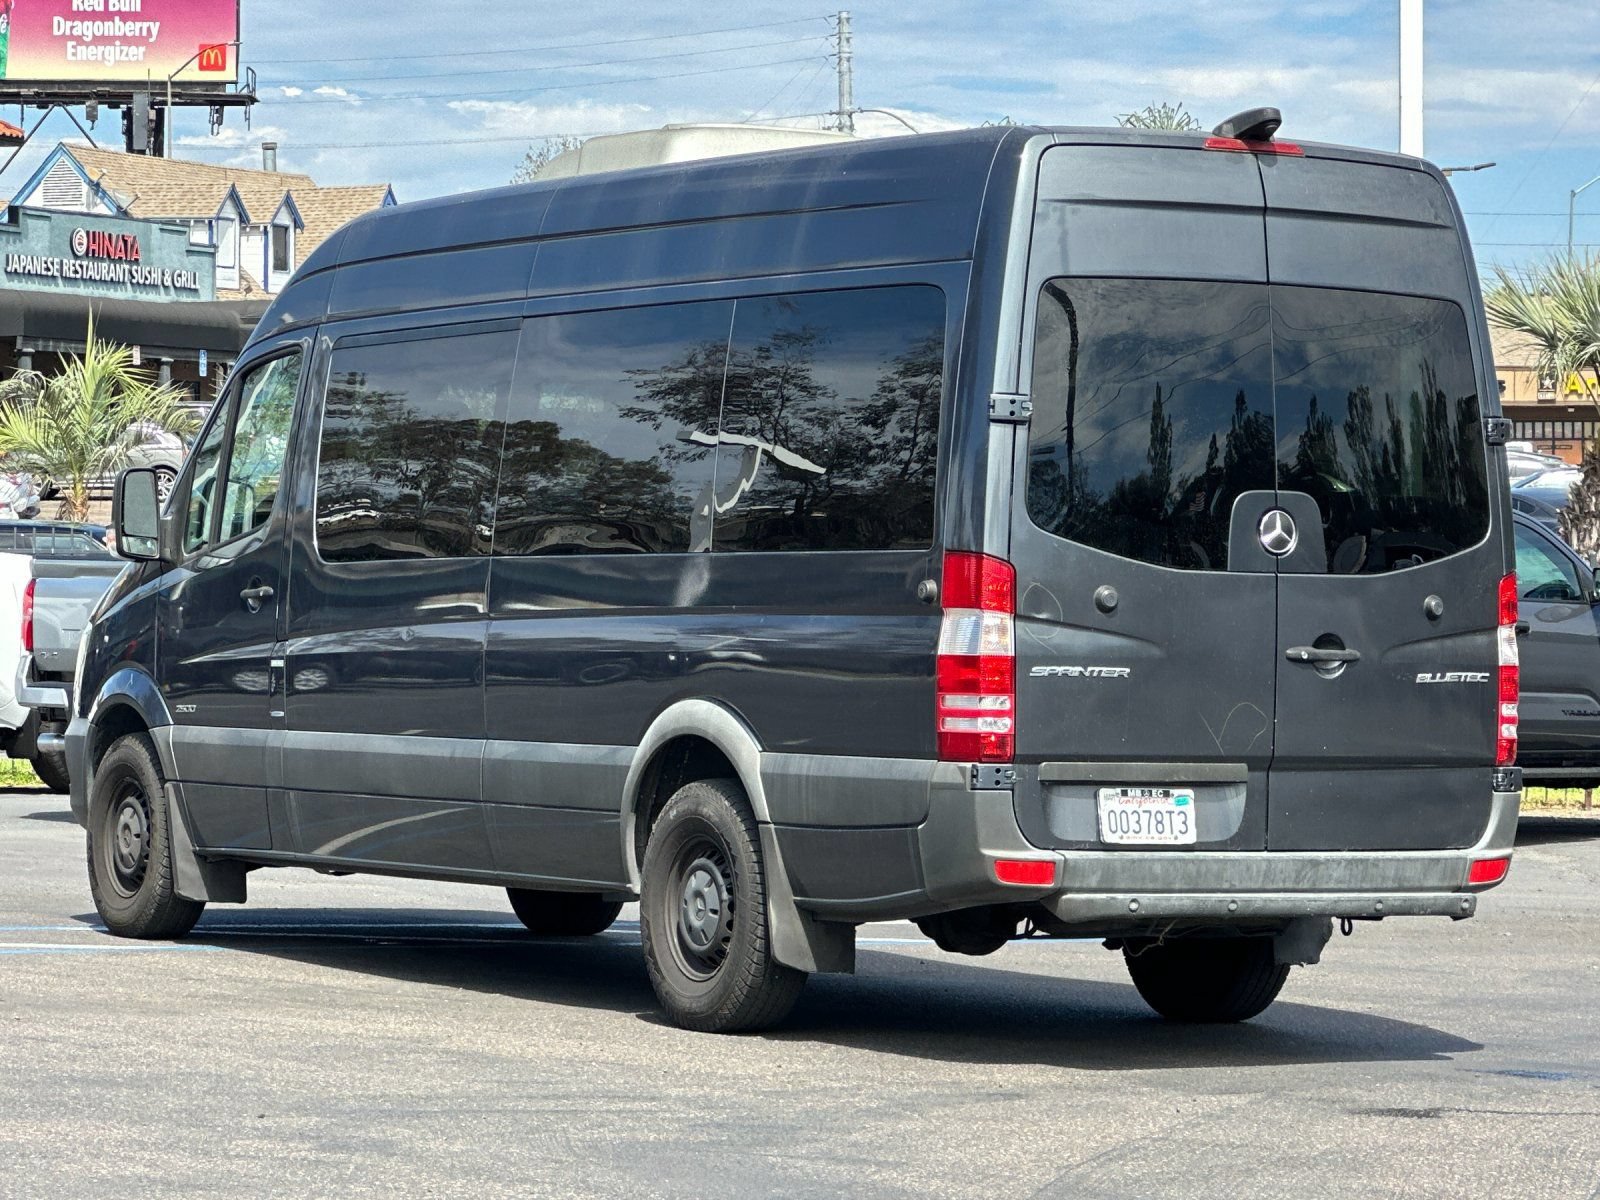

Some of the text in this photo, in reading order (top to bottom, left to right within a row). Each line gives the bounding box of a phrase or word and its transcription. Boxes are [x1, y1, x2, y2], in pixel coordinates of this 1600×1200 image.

[72, 0, 141, 12] Red Bull
[52, 15, 161, 43] Dragonberry
[66, 40, 146, 67] Energizer
[87, 230, 142, 261] HINATA
[6, 253, 201, 290] JAPANESE RESTAURANT SUSHI & GRILL
[1029, 665, 1131, 678] SPRINTER
[1415, 671, 1490, 683] BLUETEC
[1107, 809, 1189, 835] 00378T3
